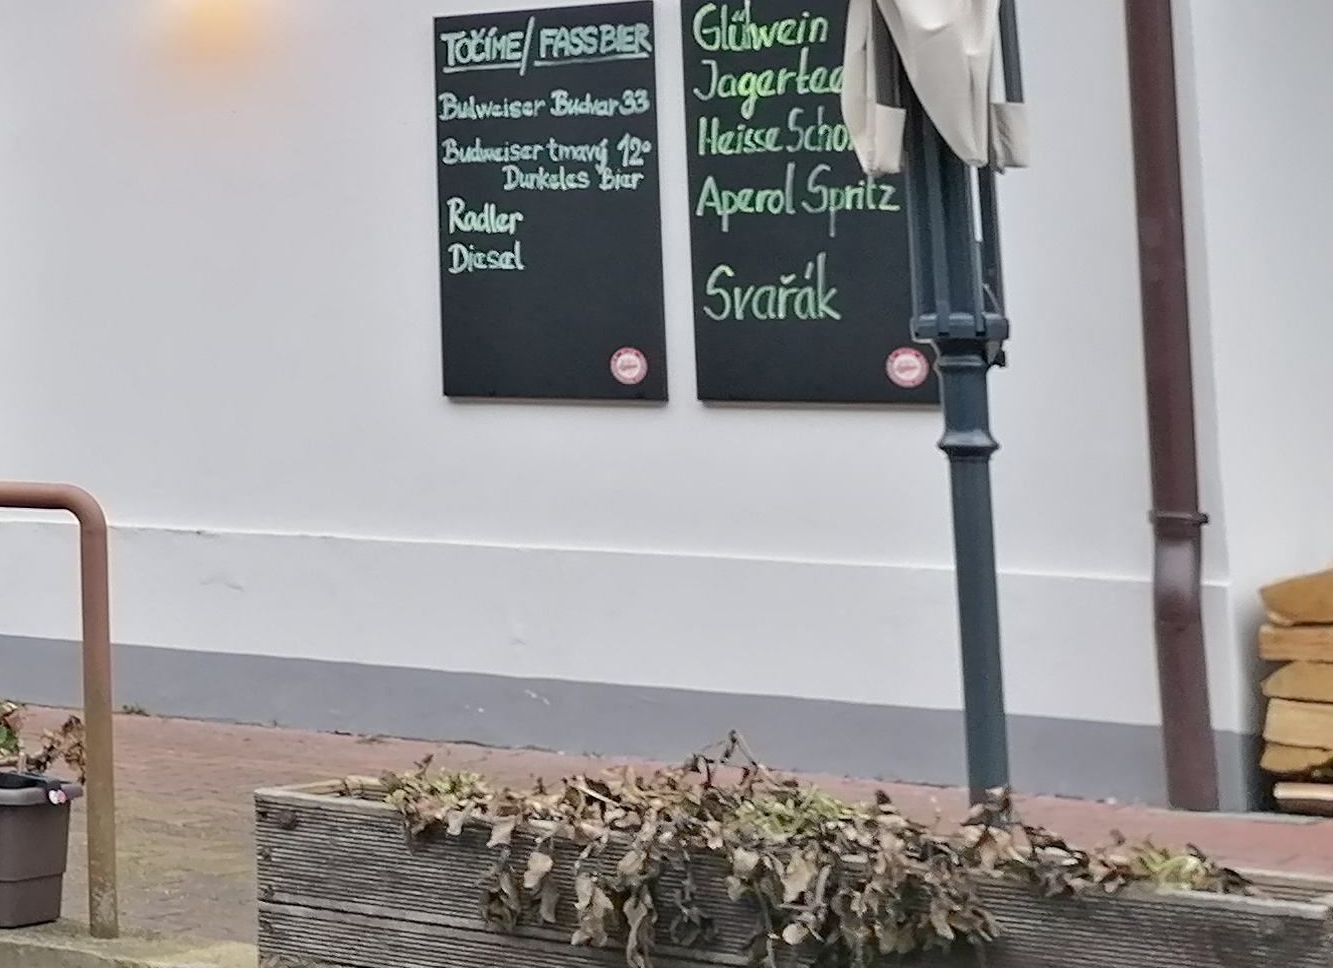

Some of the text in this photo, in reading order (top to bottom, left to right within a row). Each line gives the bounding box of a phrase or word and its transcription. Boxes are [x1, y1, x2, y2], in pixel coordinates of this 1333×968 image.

[441, 136, 544, 165] Budweiser
[697, 104, 855, 157] Heisse Scho
[597, 166, 645, 192] Bier
[695, 160, 901, 239] Aperol Spritz
[446, 195, 524, 236] Radler
[447, 239, 525, 275] Diesel
[702, 251, 842, 322] Svařák
